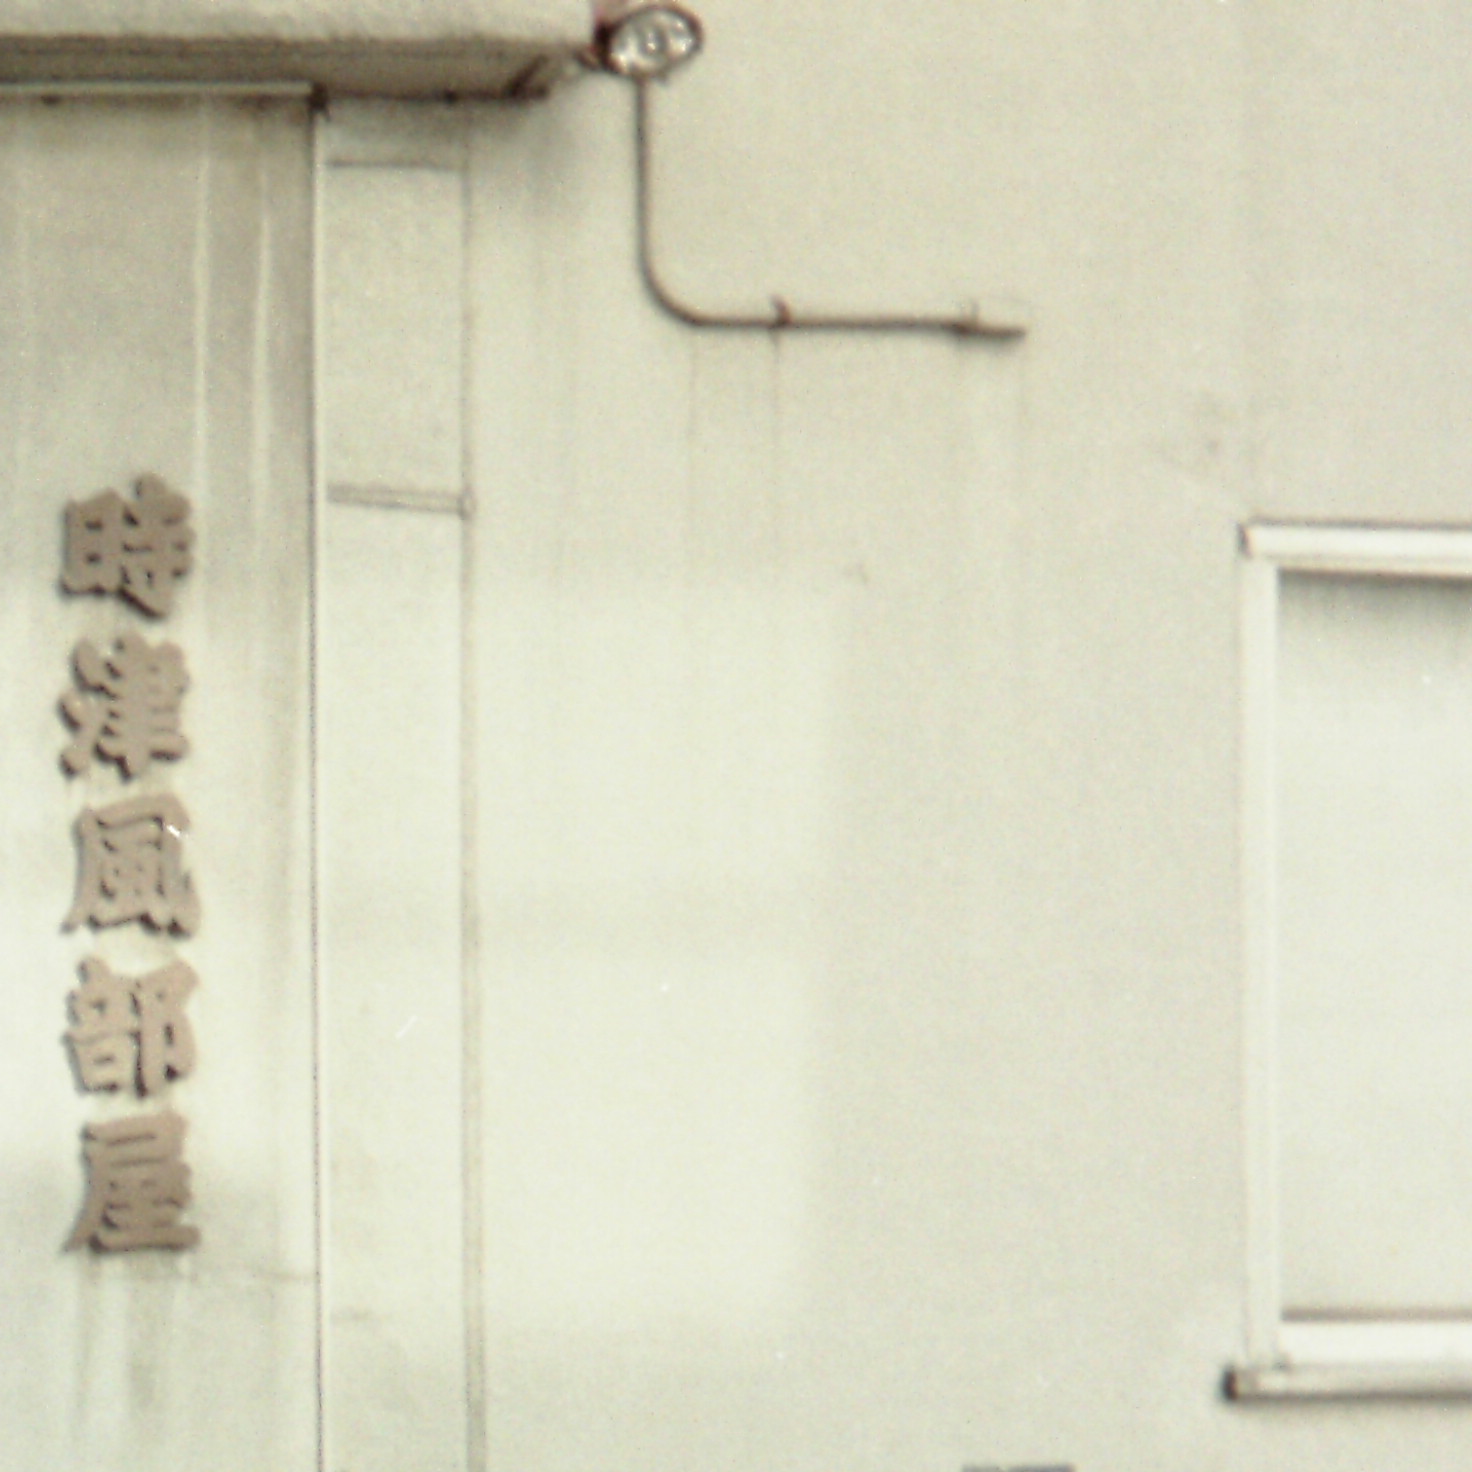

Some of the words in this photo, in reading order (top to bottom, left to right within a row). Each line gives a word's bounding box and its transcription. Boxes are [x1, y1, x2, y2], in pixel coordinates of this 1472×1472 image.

[59, 472, 200, 1253] 時津風部屋
